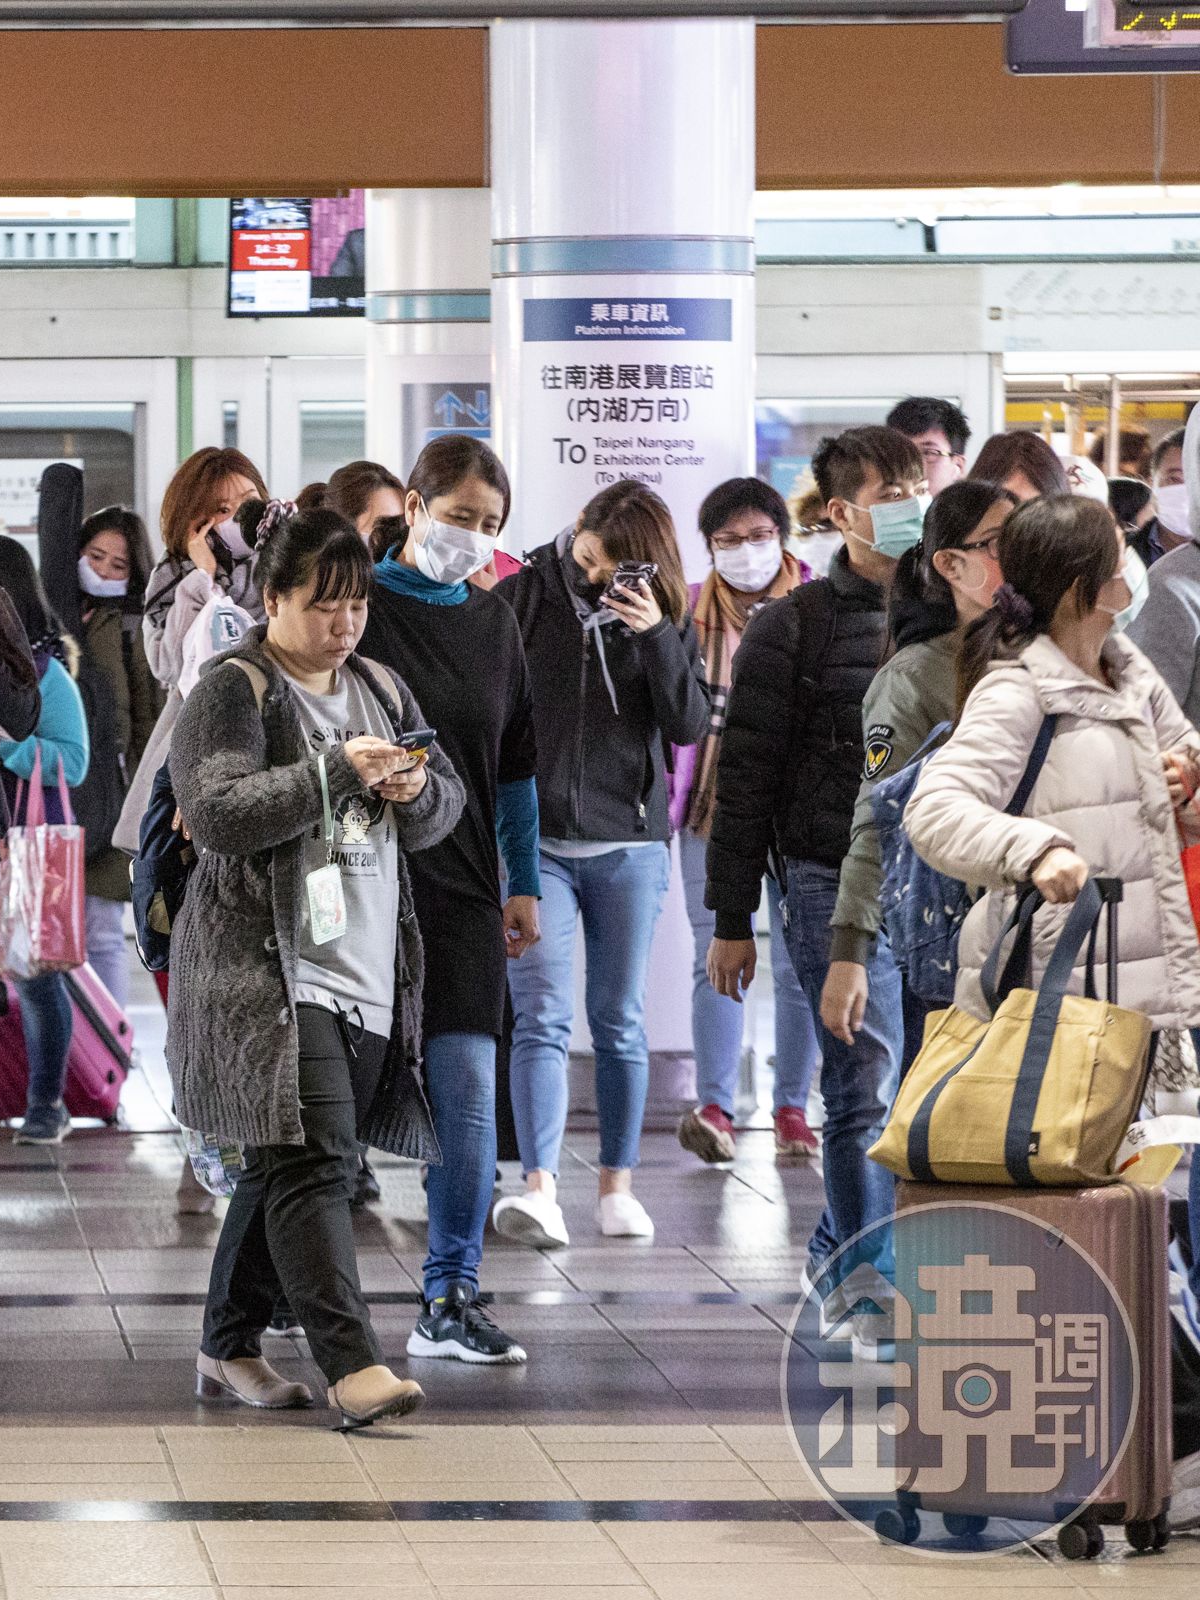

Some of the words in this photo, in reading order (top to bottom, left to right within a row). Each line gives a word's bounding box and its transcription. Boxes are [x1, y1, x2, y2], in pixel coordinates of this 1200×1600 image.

[590, 303, 670, 323] 乘車資訊
[575, 325, 622, 336] Platform
[624, 325, 686, 336] Information
[541, 363, 714, 391] 往南港展覽館站
[553, 437, 587, 464] To
[593, 436, 633, 450] Taipei
[637, 436, 695, 450] Nangang
[593, 454, 661, 466] Exhibition
[664, 454, 705, 466] Center
[595, 471, 615, 485] (To
